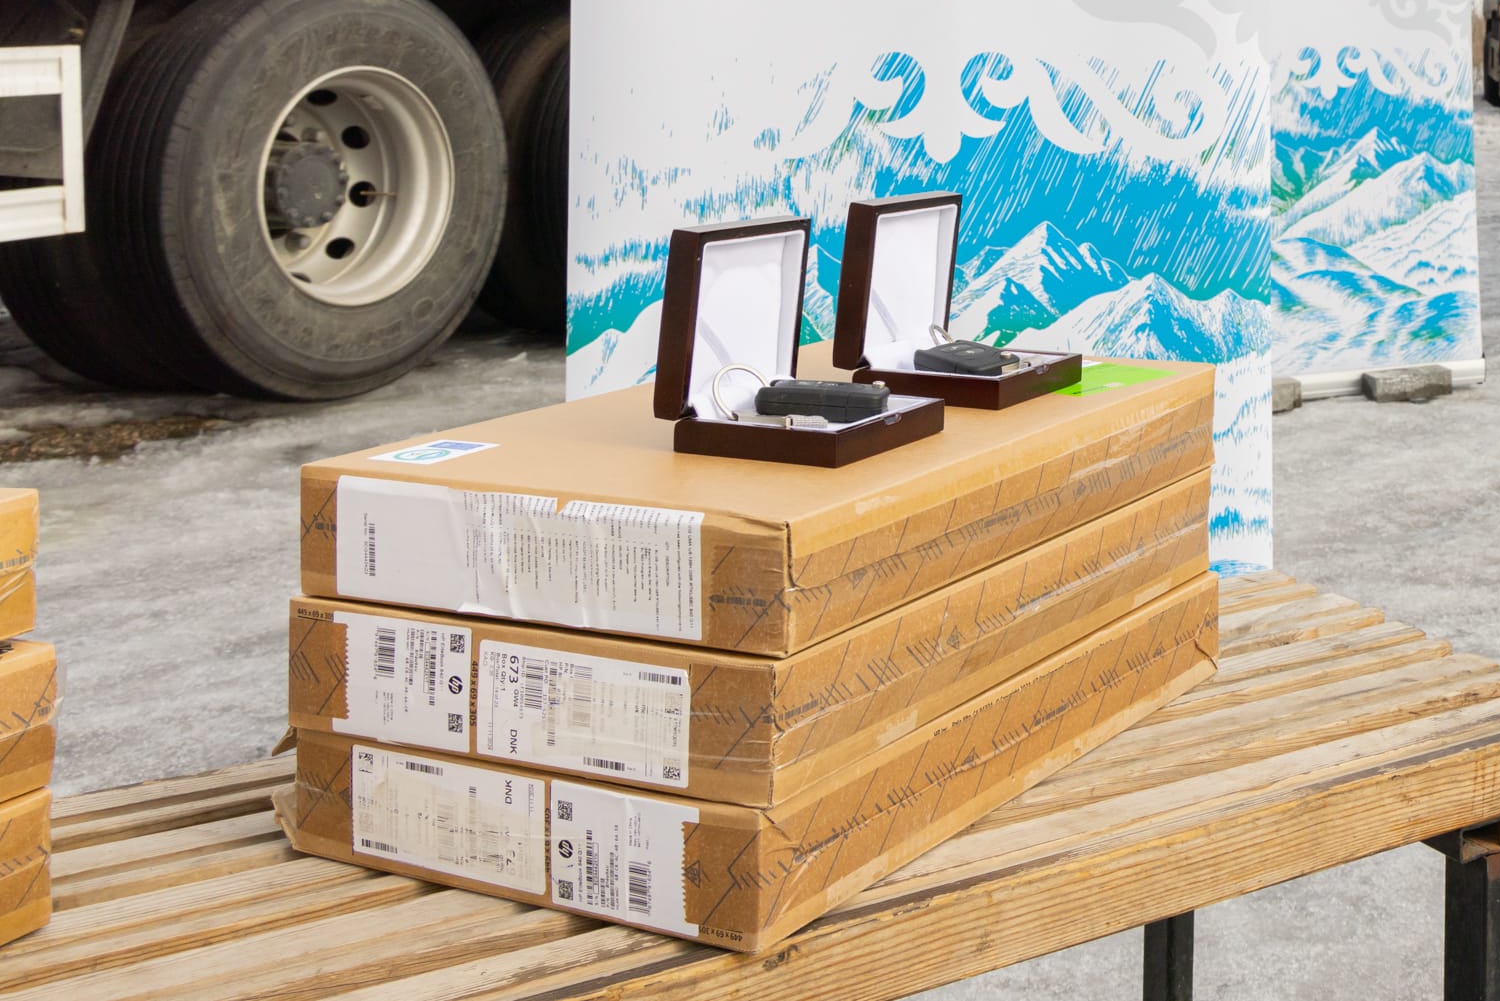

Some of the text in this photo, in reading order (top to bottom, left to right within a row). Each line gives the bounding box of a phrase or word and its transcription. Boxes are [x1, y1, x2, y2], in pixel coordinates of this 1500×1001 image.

[509, 655, 519, 684] 673
[471, 688, 478, 700] 69
[510, 729, 518, 754] DNK
[558, 840, 573, 858] hp
